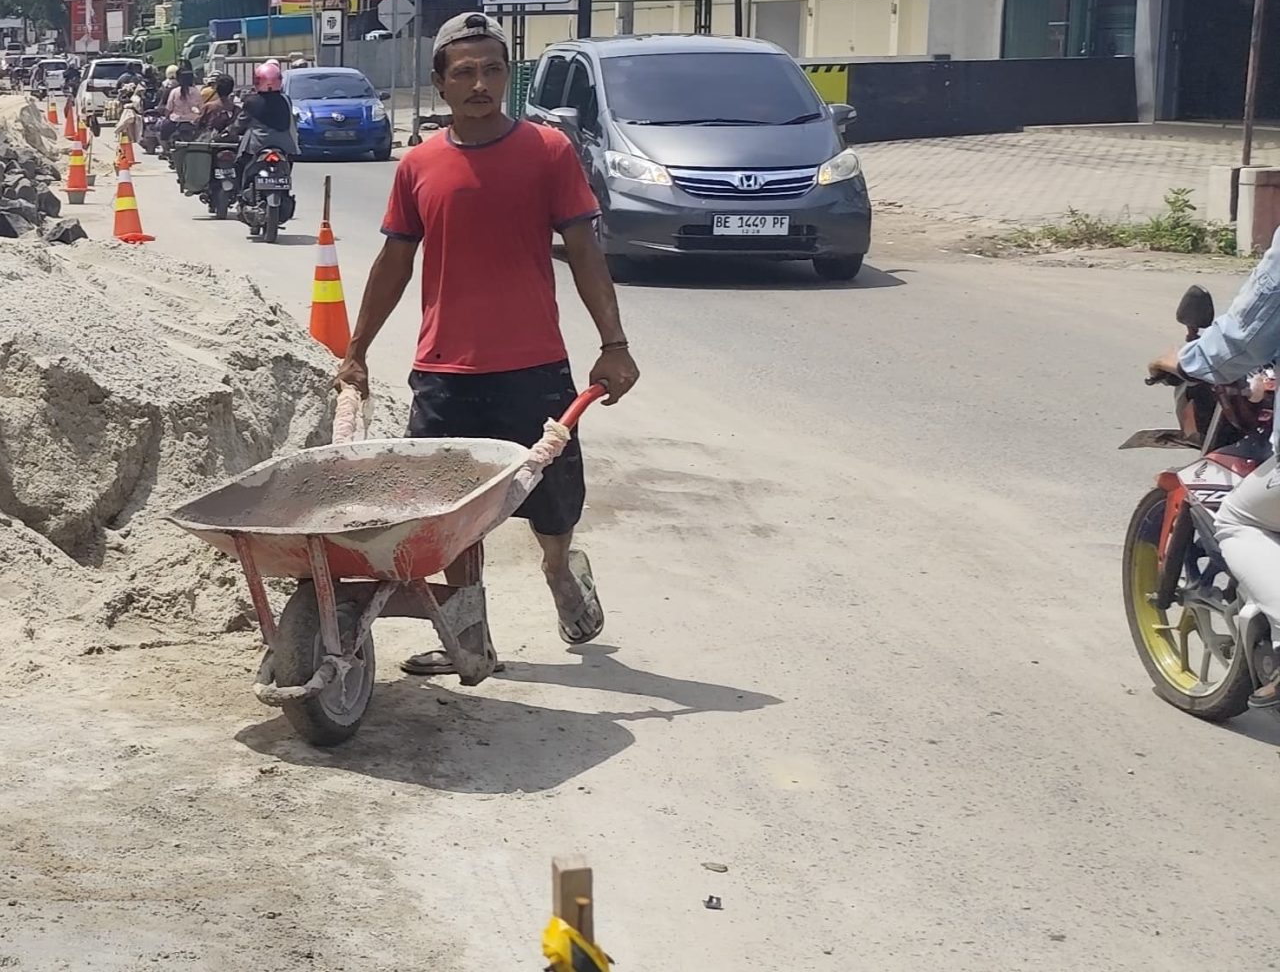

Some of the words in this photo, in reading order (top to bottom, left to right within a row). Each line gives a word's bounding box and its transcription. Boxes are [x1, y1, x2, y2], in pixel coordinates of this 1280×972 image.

[716, 216, 731, 228] BE
[738, 216, 767, 228] 1449
[773, 216, 787, 228] PF
